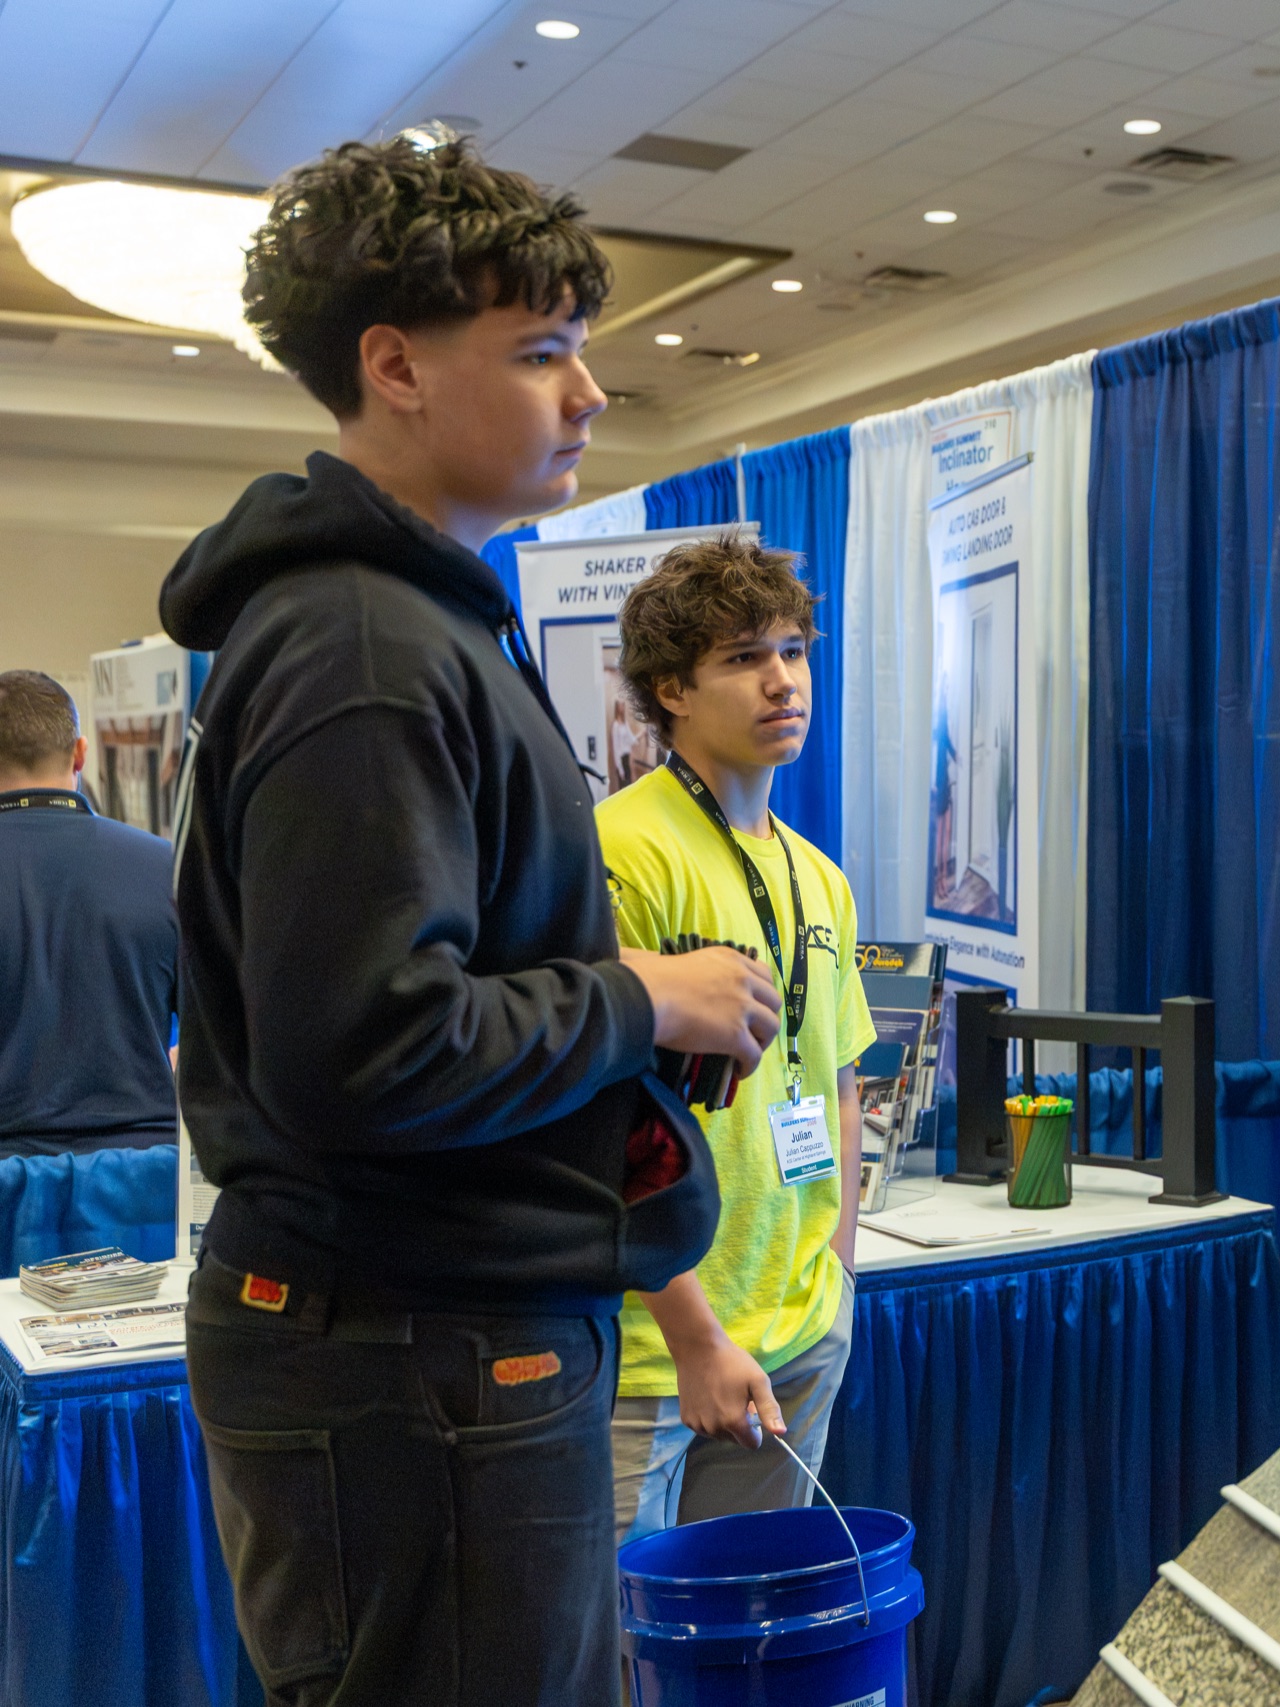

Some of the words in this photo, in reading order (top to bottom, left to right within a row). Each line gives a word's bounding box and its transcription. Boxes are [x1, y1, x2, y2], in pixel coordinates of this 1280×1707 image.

[939, 445, 994, 473] Inclinator
[981, 499, 1000, 524] DOOR
[994, 524, 1013, 549] DOOR
[584, 556, 646, 577] SHAKER
[558, 585, 598, 603] WITH
[991, 946, 1025, 968] Automation
[791, 1130, 813, 1143] Julian
[801, 1165, 817, 1173] Student
